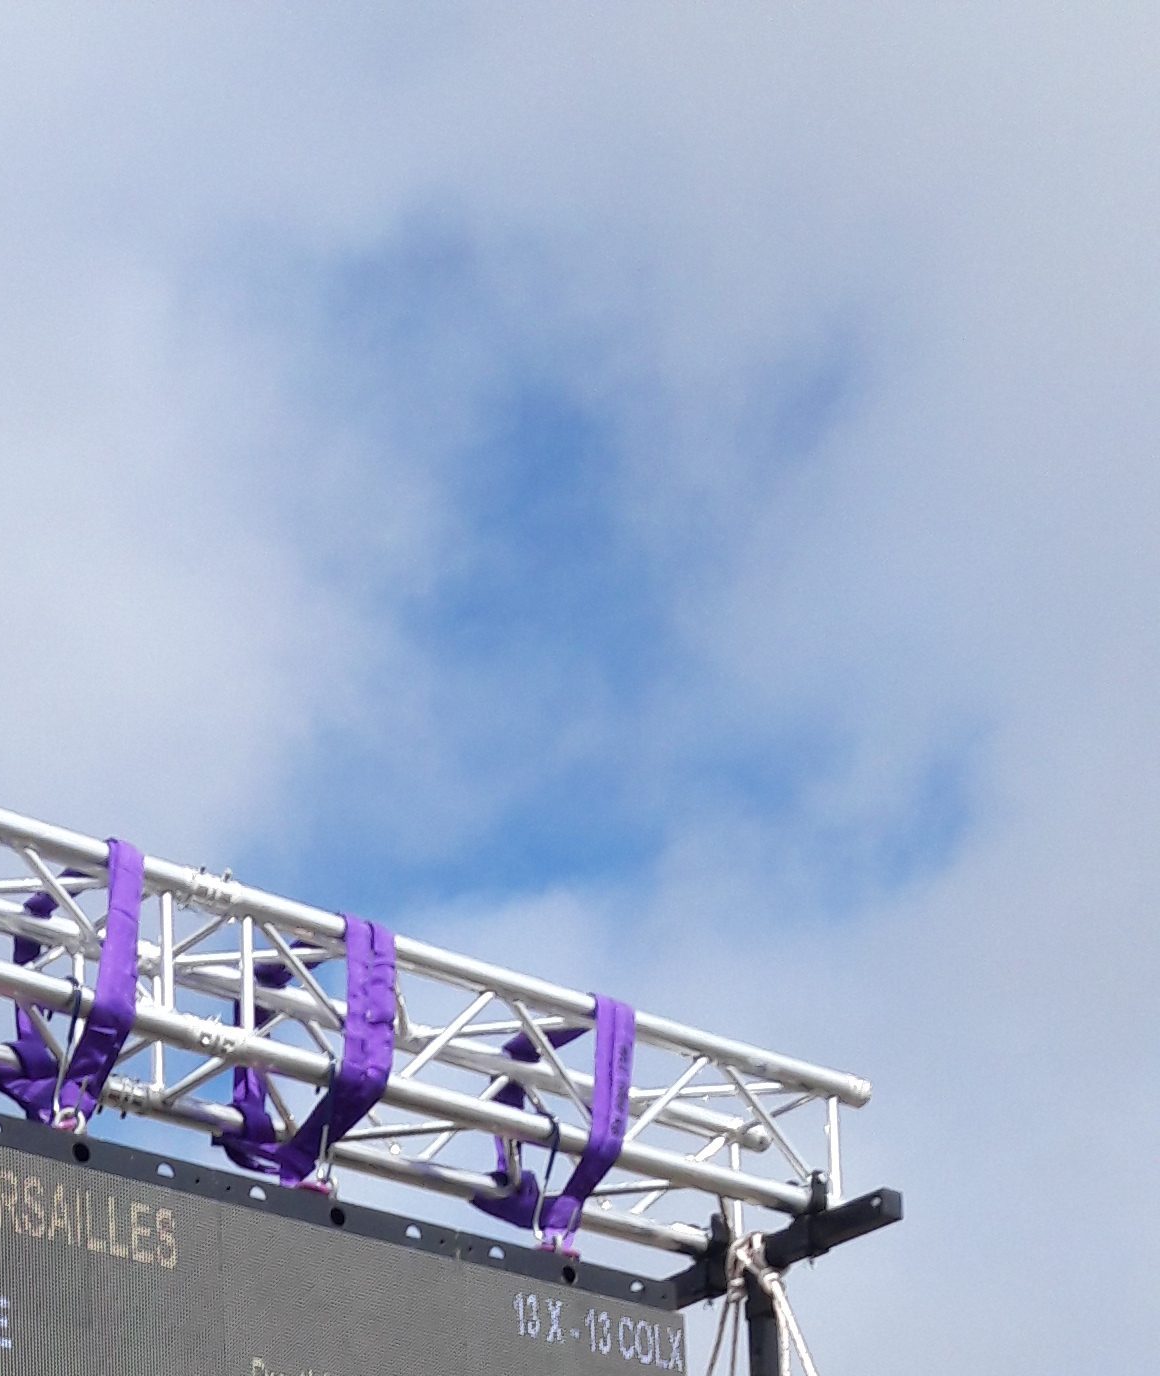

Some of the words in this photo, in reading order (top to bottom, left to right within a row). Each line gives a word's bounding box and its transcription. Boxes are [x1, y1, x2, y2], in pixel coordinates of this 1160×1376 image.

[513, 1292, 540, 1338] 13
[546, 1299, 566, 1343] X
[585, 1309, 611, 1354] 13
[619, 1316, 683, 1372] COLX
